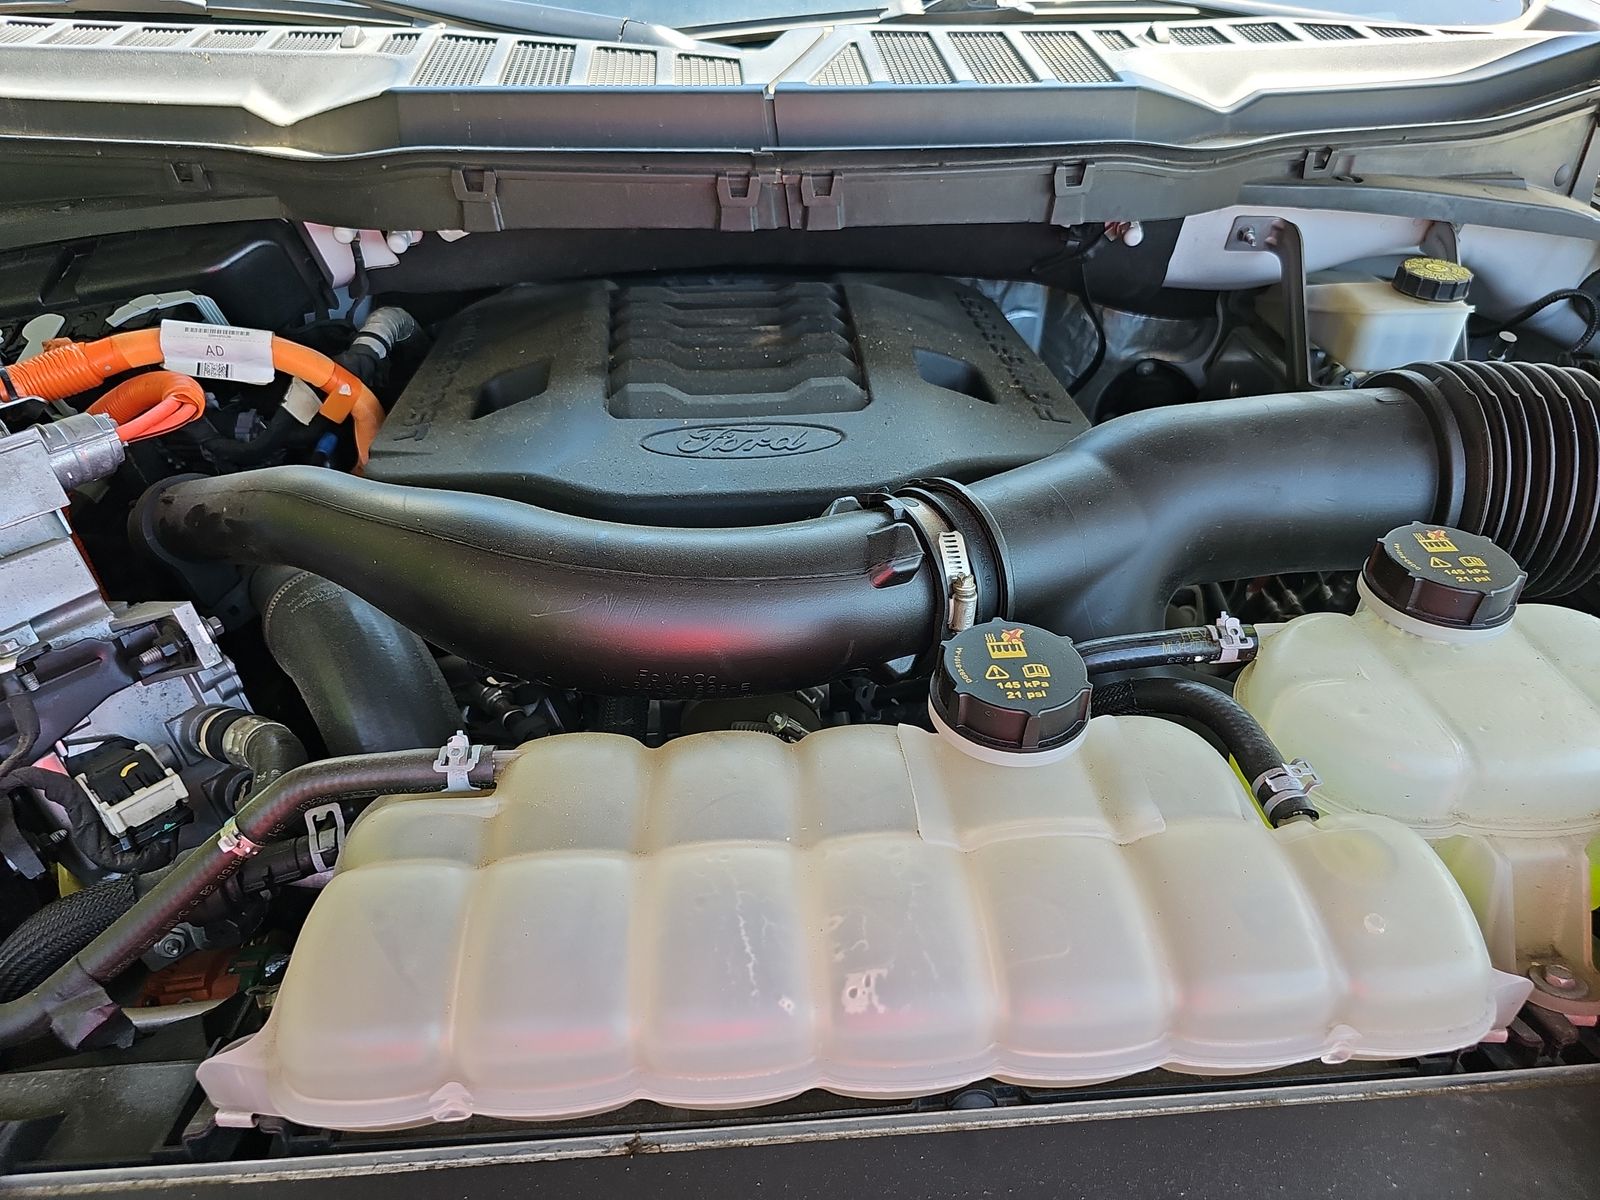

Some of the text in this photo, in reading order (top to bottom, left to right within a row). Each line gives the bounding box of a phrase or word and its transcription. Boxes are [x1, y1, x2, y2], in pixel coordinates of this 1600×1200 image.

[206, 345, 225, 357] AD
[677, 427, 808, 454] Ford
[1473, 575, 1492, 583] psi
[996, 680, 1050, 690] 145 kPa
[1006, 690, 1047, 700] 21 psi
